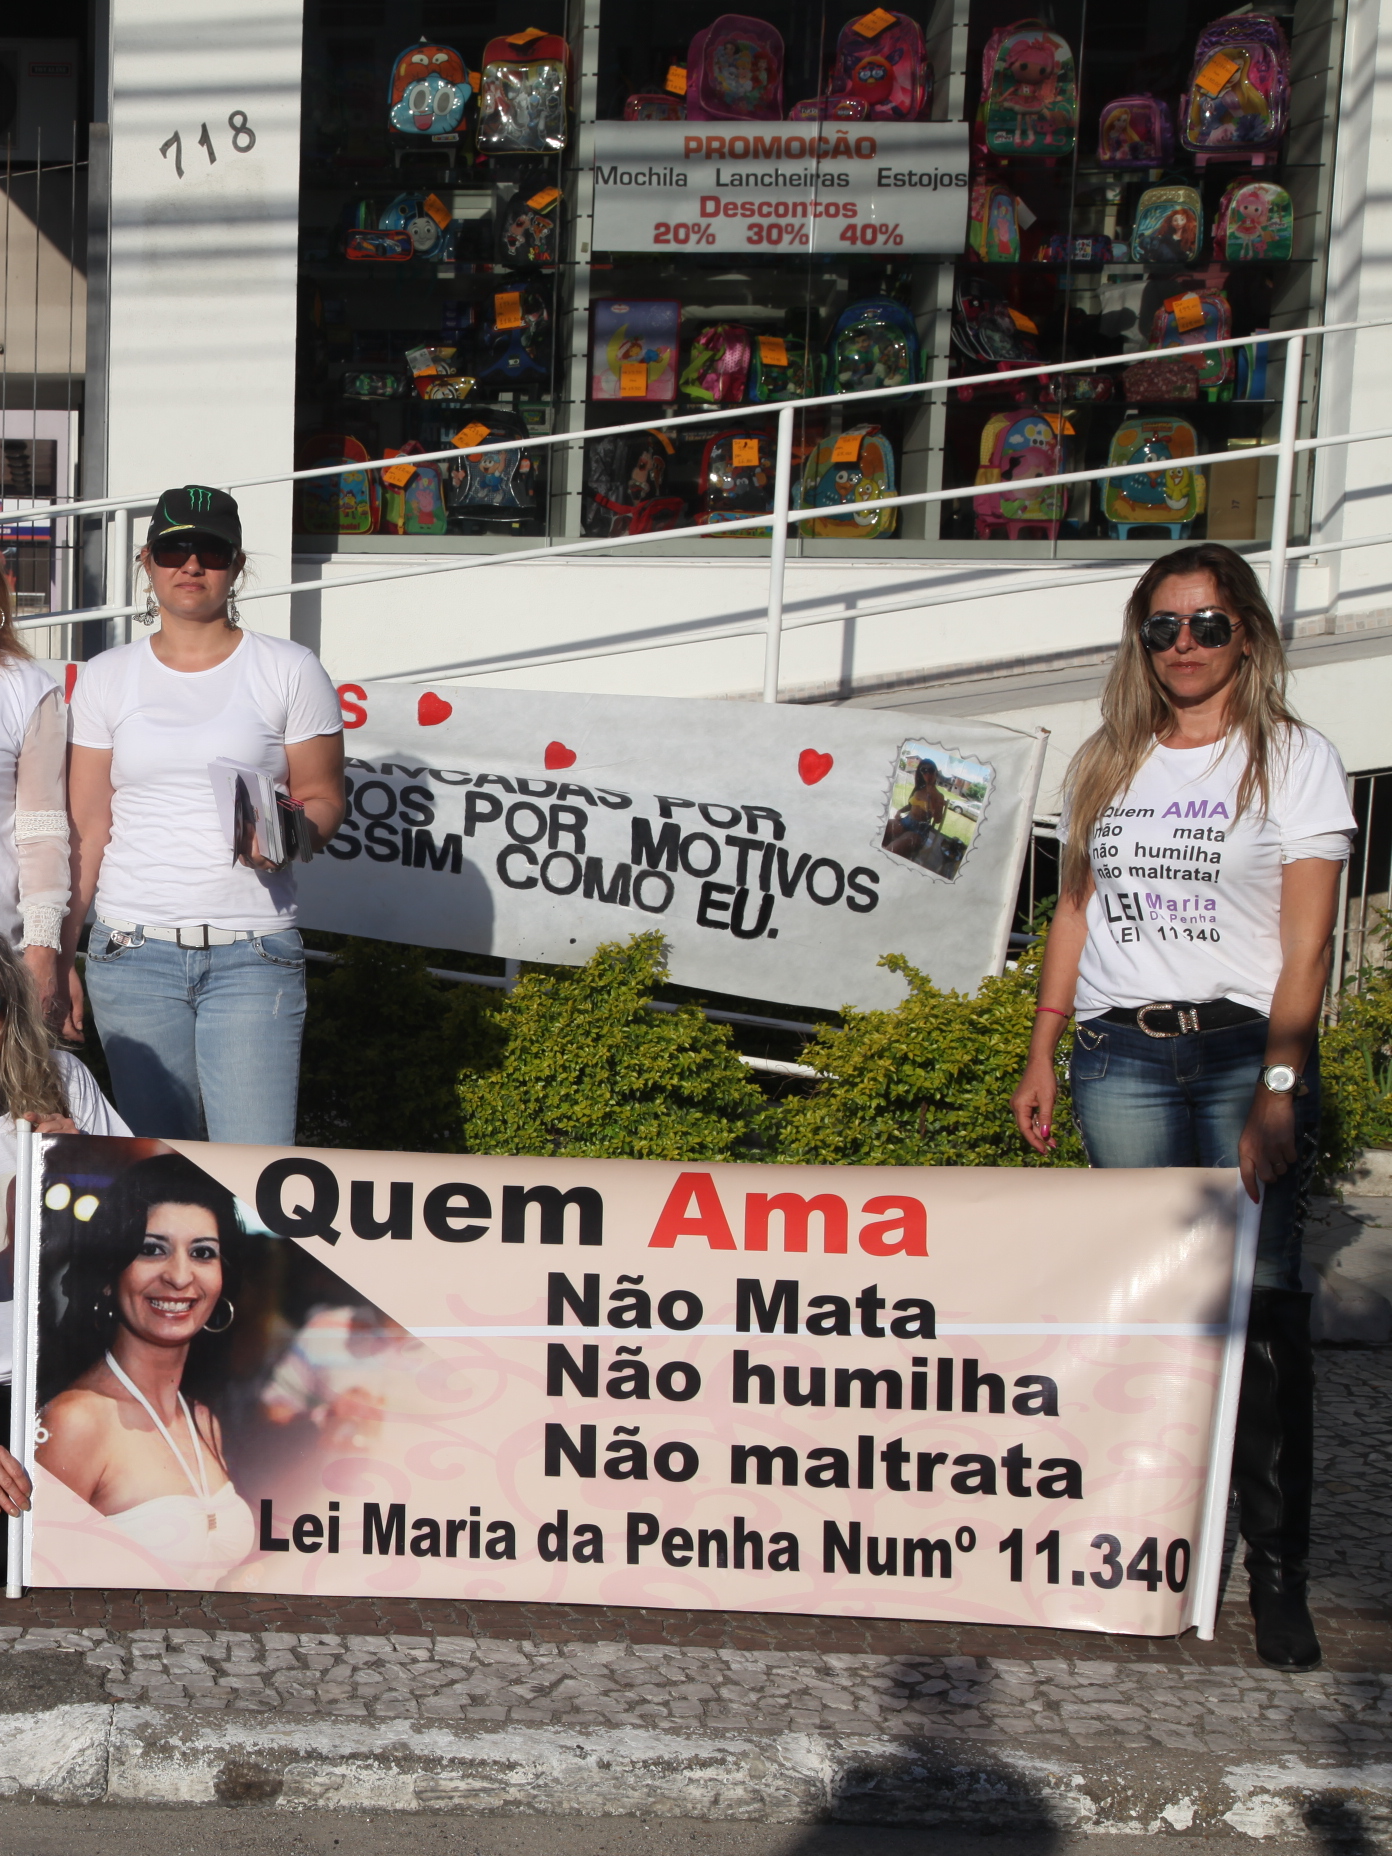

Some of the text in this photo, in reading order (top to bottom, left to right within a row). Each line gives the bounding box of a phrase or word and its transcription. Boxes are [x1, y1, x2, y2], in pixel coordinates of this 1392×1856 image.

[159, 109, 257, 178] 718
[594, 166, 968, 191] Mochila Lancheiras Estojos
[699, 195, 858, 219] Descontos
[653, 222, 904, 246] 20% 30% 40%
[653, 793, 787, 841] POR
[1102, 799, 1230, 819] Quem AMA
[1093, 822, 1226, 843] não mata
[464, 789, 589, 855] POR
[631, 816, 881, 914] MOTIVOS
[1092, 841, 1222, 864] não humilha
[314, 817, 779, 940] SSIM COMO EU.
[1097, 863, 1221, 884] não maltrata!
[1104, 891, 1217, 923] LEI Maria
[1169, 913, 1217, 924] Penha
[1157, 925, 1221, 943] 11340
[255, 1157, 929, 1257] Quem Ama
[548, 1273, 936, 1339] Não Mata
[547, 1344, 1058, 1416] Não humilha
[545, 1423, 1082, 1499] Não maltrata
[260, 1499, 1190, 1593] Lei Maria da Penha Numº 11.340
